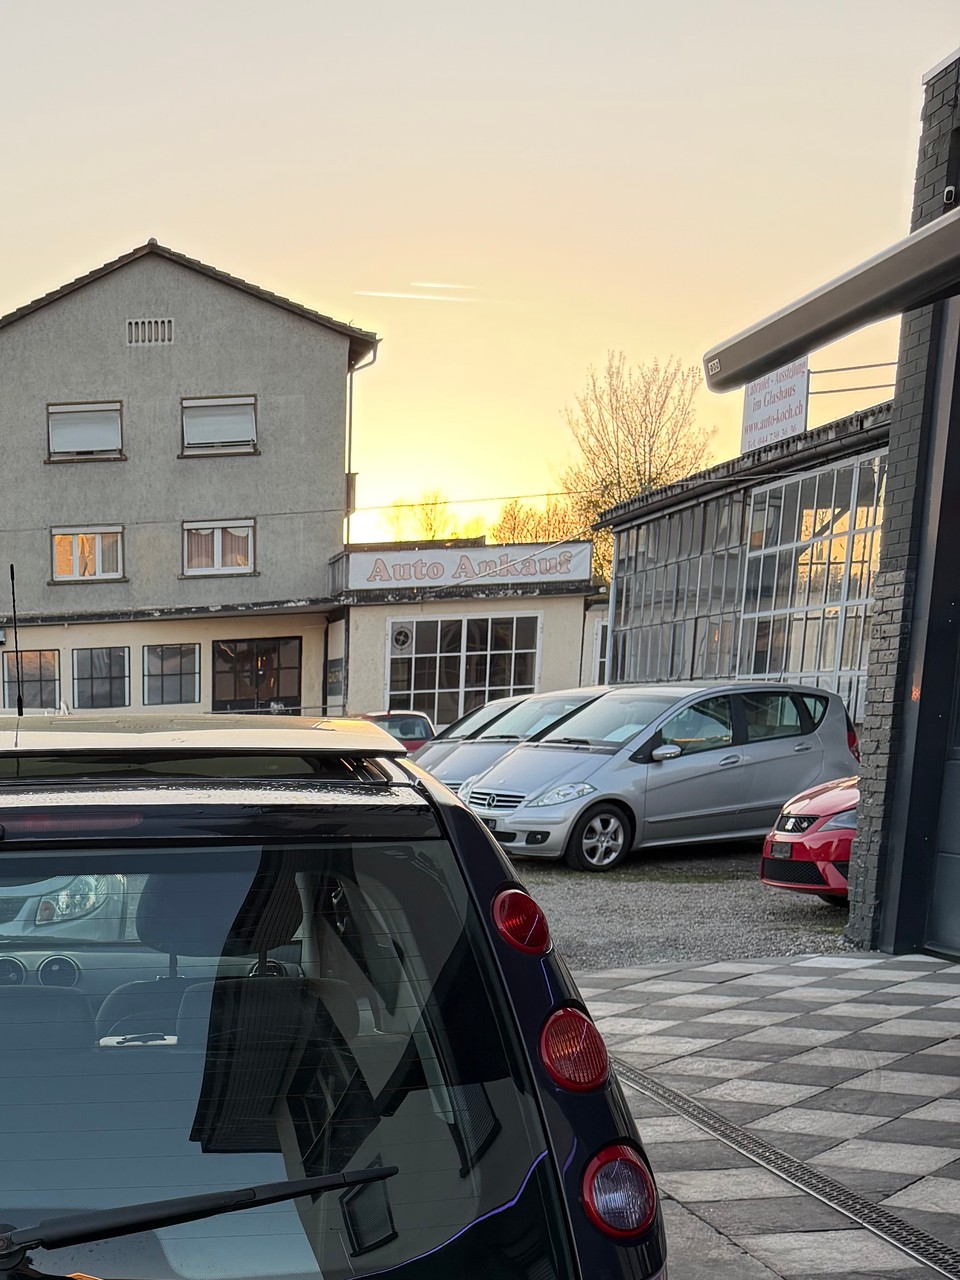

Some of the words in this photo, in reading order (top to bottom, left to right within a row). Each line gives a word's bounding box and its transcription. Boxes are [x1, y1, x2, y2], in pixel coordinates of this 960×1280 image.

[752, 398, 761, 412] im
[763, 385, 796, 407] Glashaus
[744, 400, 803, 435] www.auto-koch.ch
[367, 558, 444, 582] Auto
[452, 550, 573, 579] Ankauf
